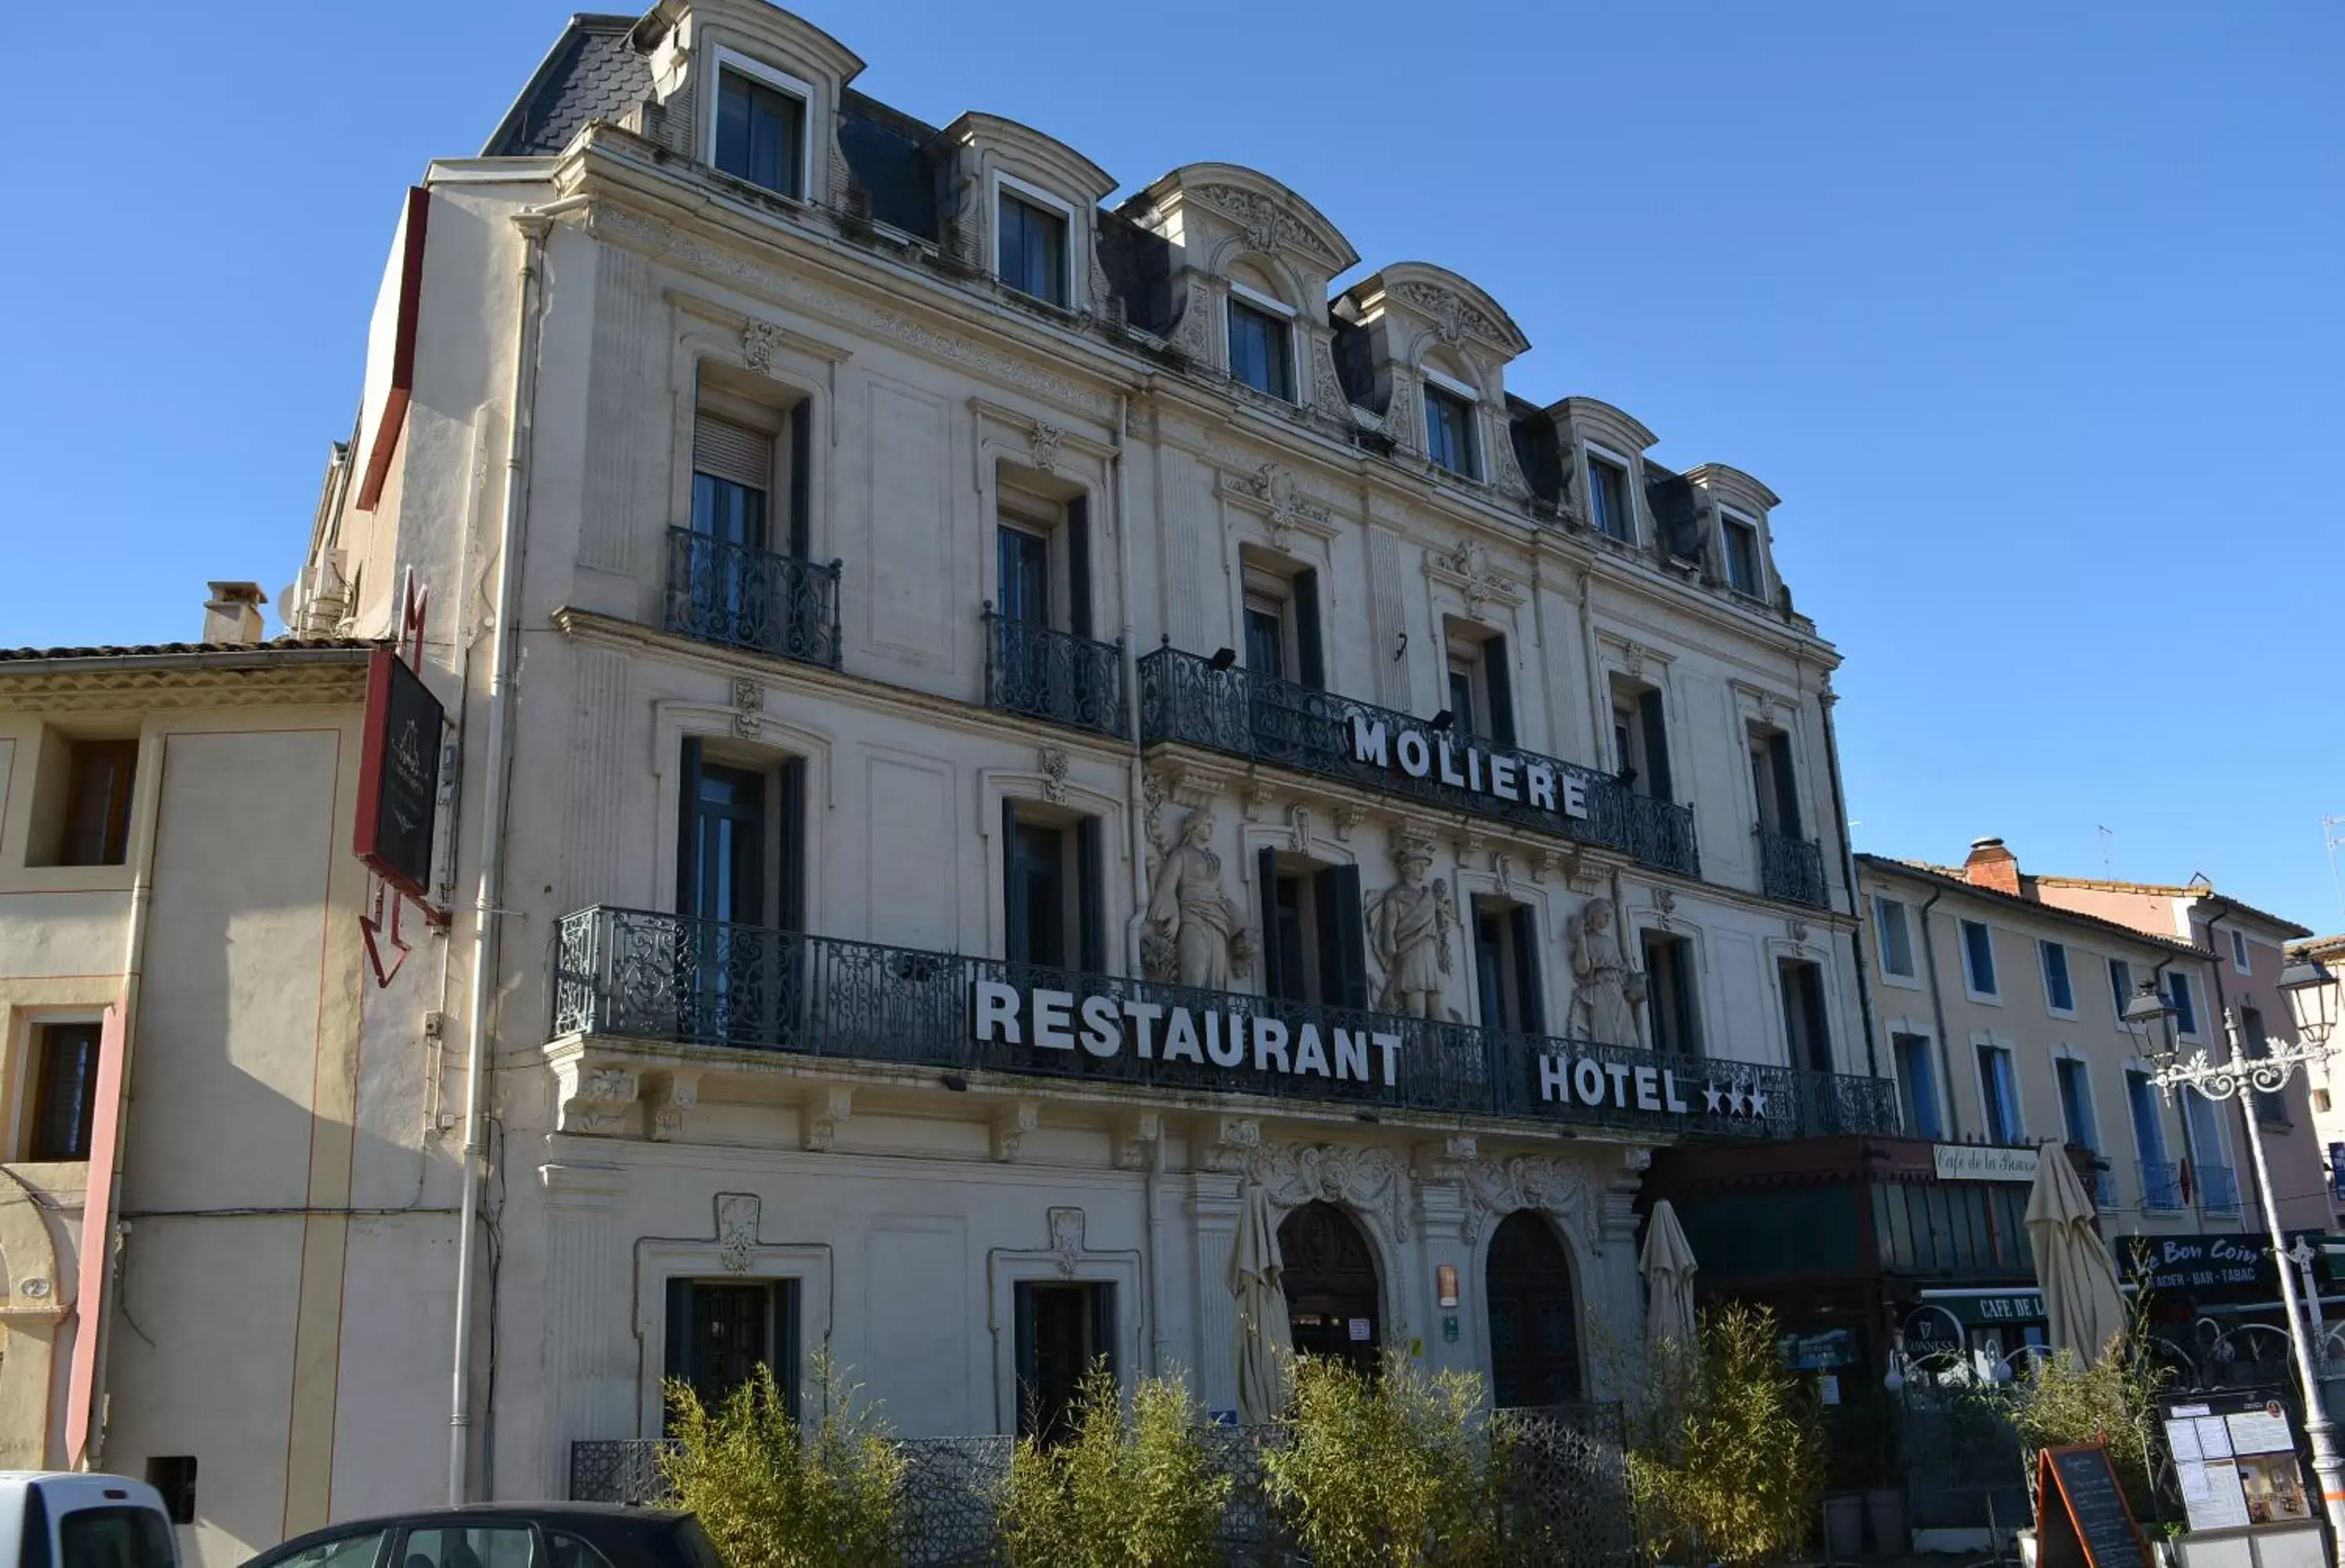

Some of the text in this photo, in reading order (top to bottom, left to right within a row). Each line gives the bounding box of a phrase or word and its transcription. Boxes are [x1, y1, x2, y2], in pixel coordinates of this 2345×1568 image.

[1352, 713, 1588, 819] MOLIERE
[975, 980, 1402, 1086] RESTAURANT
[1539, 1054, 1687, 1113] HOTEL
[2163, 1240, 2202, 1264] Bon
[2222, 1267, 2256, 1283] TABAC
[1980, 1298, 2013, 1319] CAFE
[2014, 1298, 2032, 1317] DE
